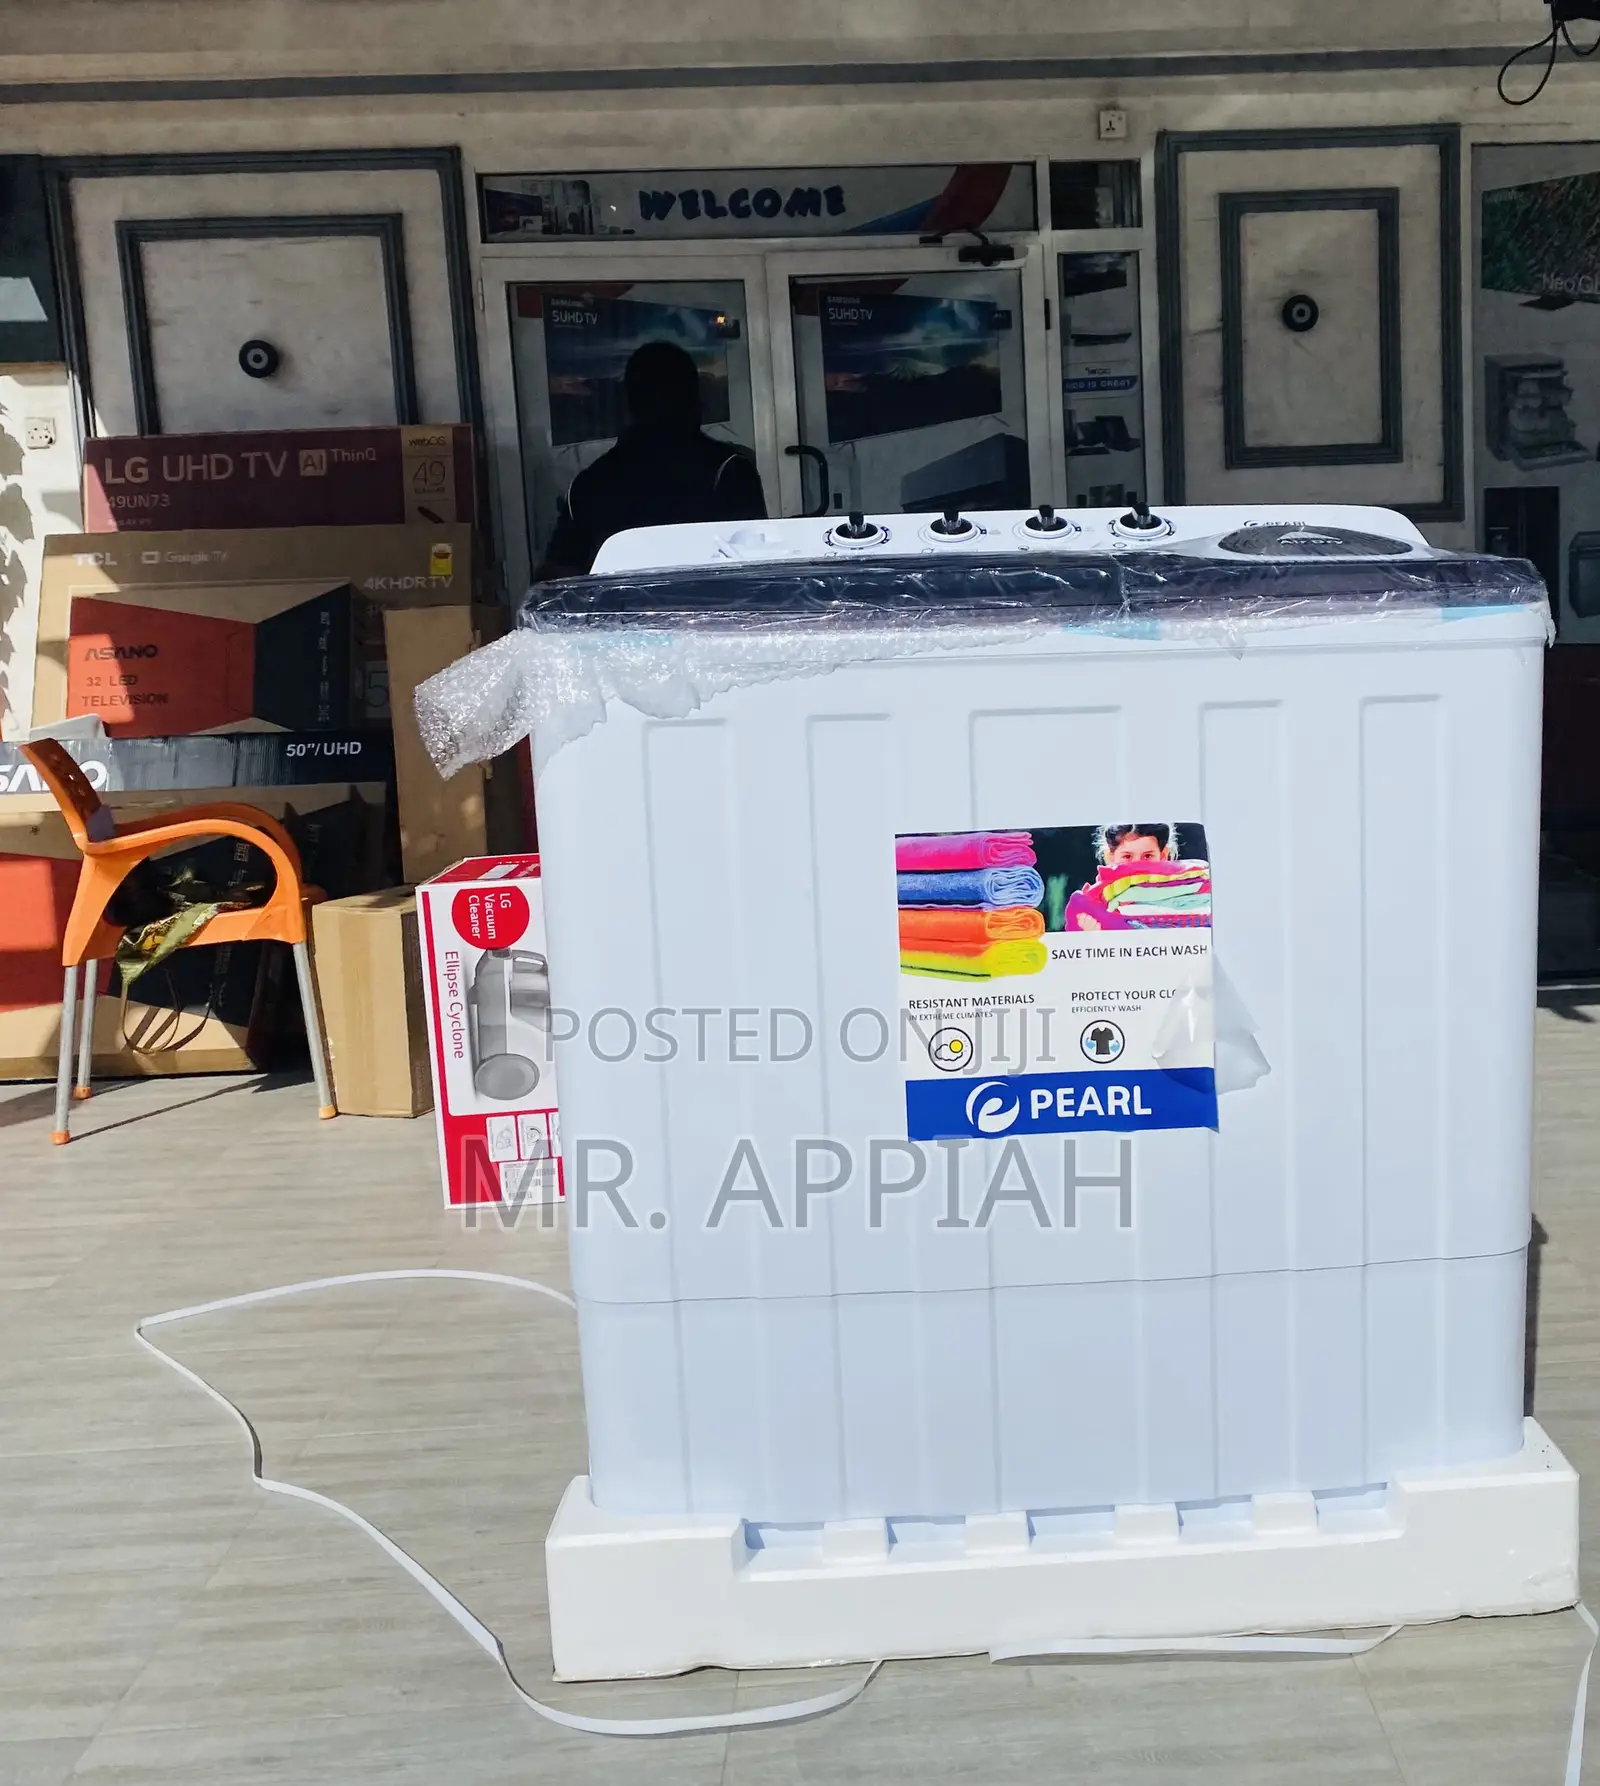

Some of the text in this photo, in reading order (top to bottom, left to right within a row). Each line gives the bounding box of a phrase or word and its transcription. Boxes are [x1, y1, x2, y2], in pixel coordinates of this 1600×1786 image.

[638, 185, 846, 220] WELCOME
[104, 447, 377, 485] LG UHD TV AI ThinQ
[412, 460, 446, 486] 49
[85, 644, 159, 661] ASANO
[86, 674, 139, 687] 32 LED
[82, 692, 169, 708] TELEVISION
[500, 892, 511, 909] LG
[468, 894, 481, 939] Cleaner
[485, 893, 497, 940] Vacuum
[1051, 944, 1208, 960] SAVE TIME IN EACH WASH
[908, 993, 1036, 1010] RESISTANT MATERIALS
[1071, 990, 1121, 1002] PROTECT
[1124, 989, 1157, 1001] YOUR
[443, 951, 464, 1060] Ellipse Cyclone
[1071, 1004, 1142, 1014] EFFICIENTLY WASH
[918, 1011, 954, 1021] EXTREME
[955, 1009, 994, 1020] CLIMATES
[1029, 1085, 1153, 1120] PEARL
